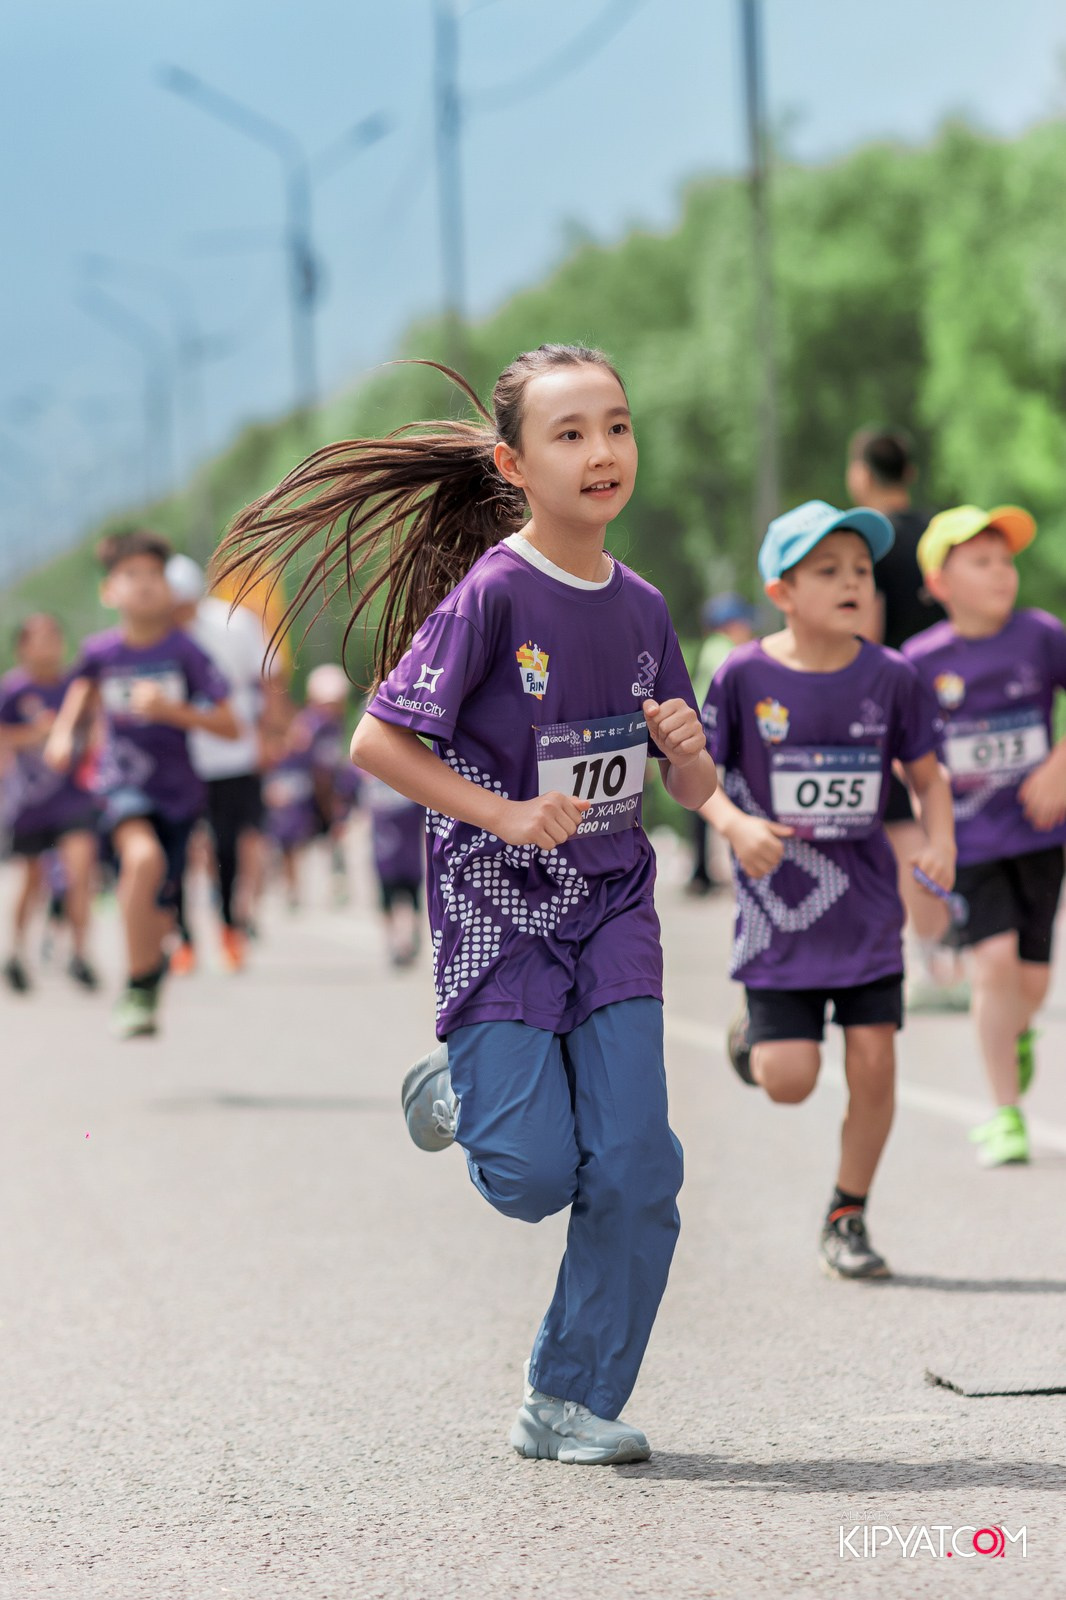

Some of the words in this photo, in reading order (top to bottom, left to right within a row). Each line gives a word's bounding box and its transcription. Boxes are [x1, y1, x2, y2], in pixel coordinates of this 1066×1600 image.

[395, 695, 421, 710] Arena
[423, 702, 446, 717] City
[572, 755, 627, 799] 110
[796, 778, 866, 808] 055
[595, 796, 639, 818] ЖАРЫСЫ
[576, 820, 599, 835] 600
